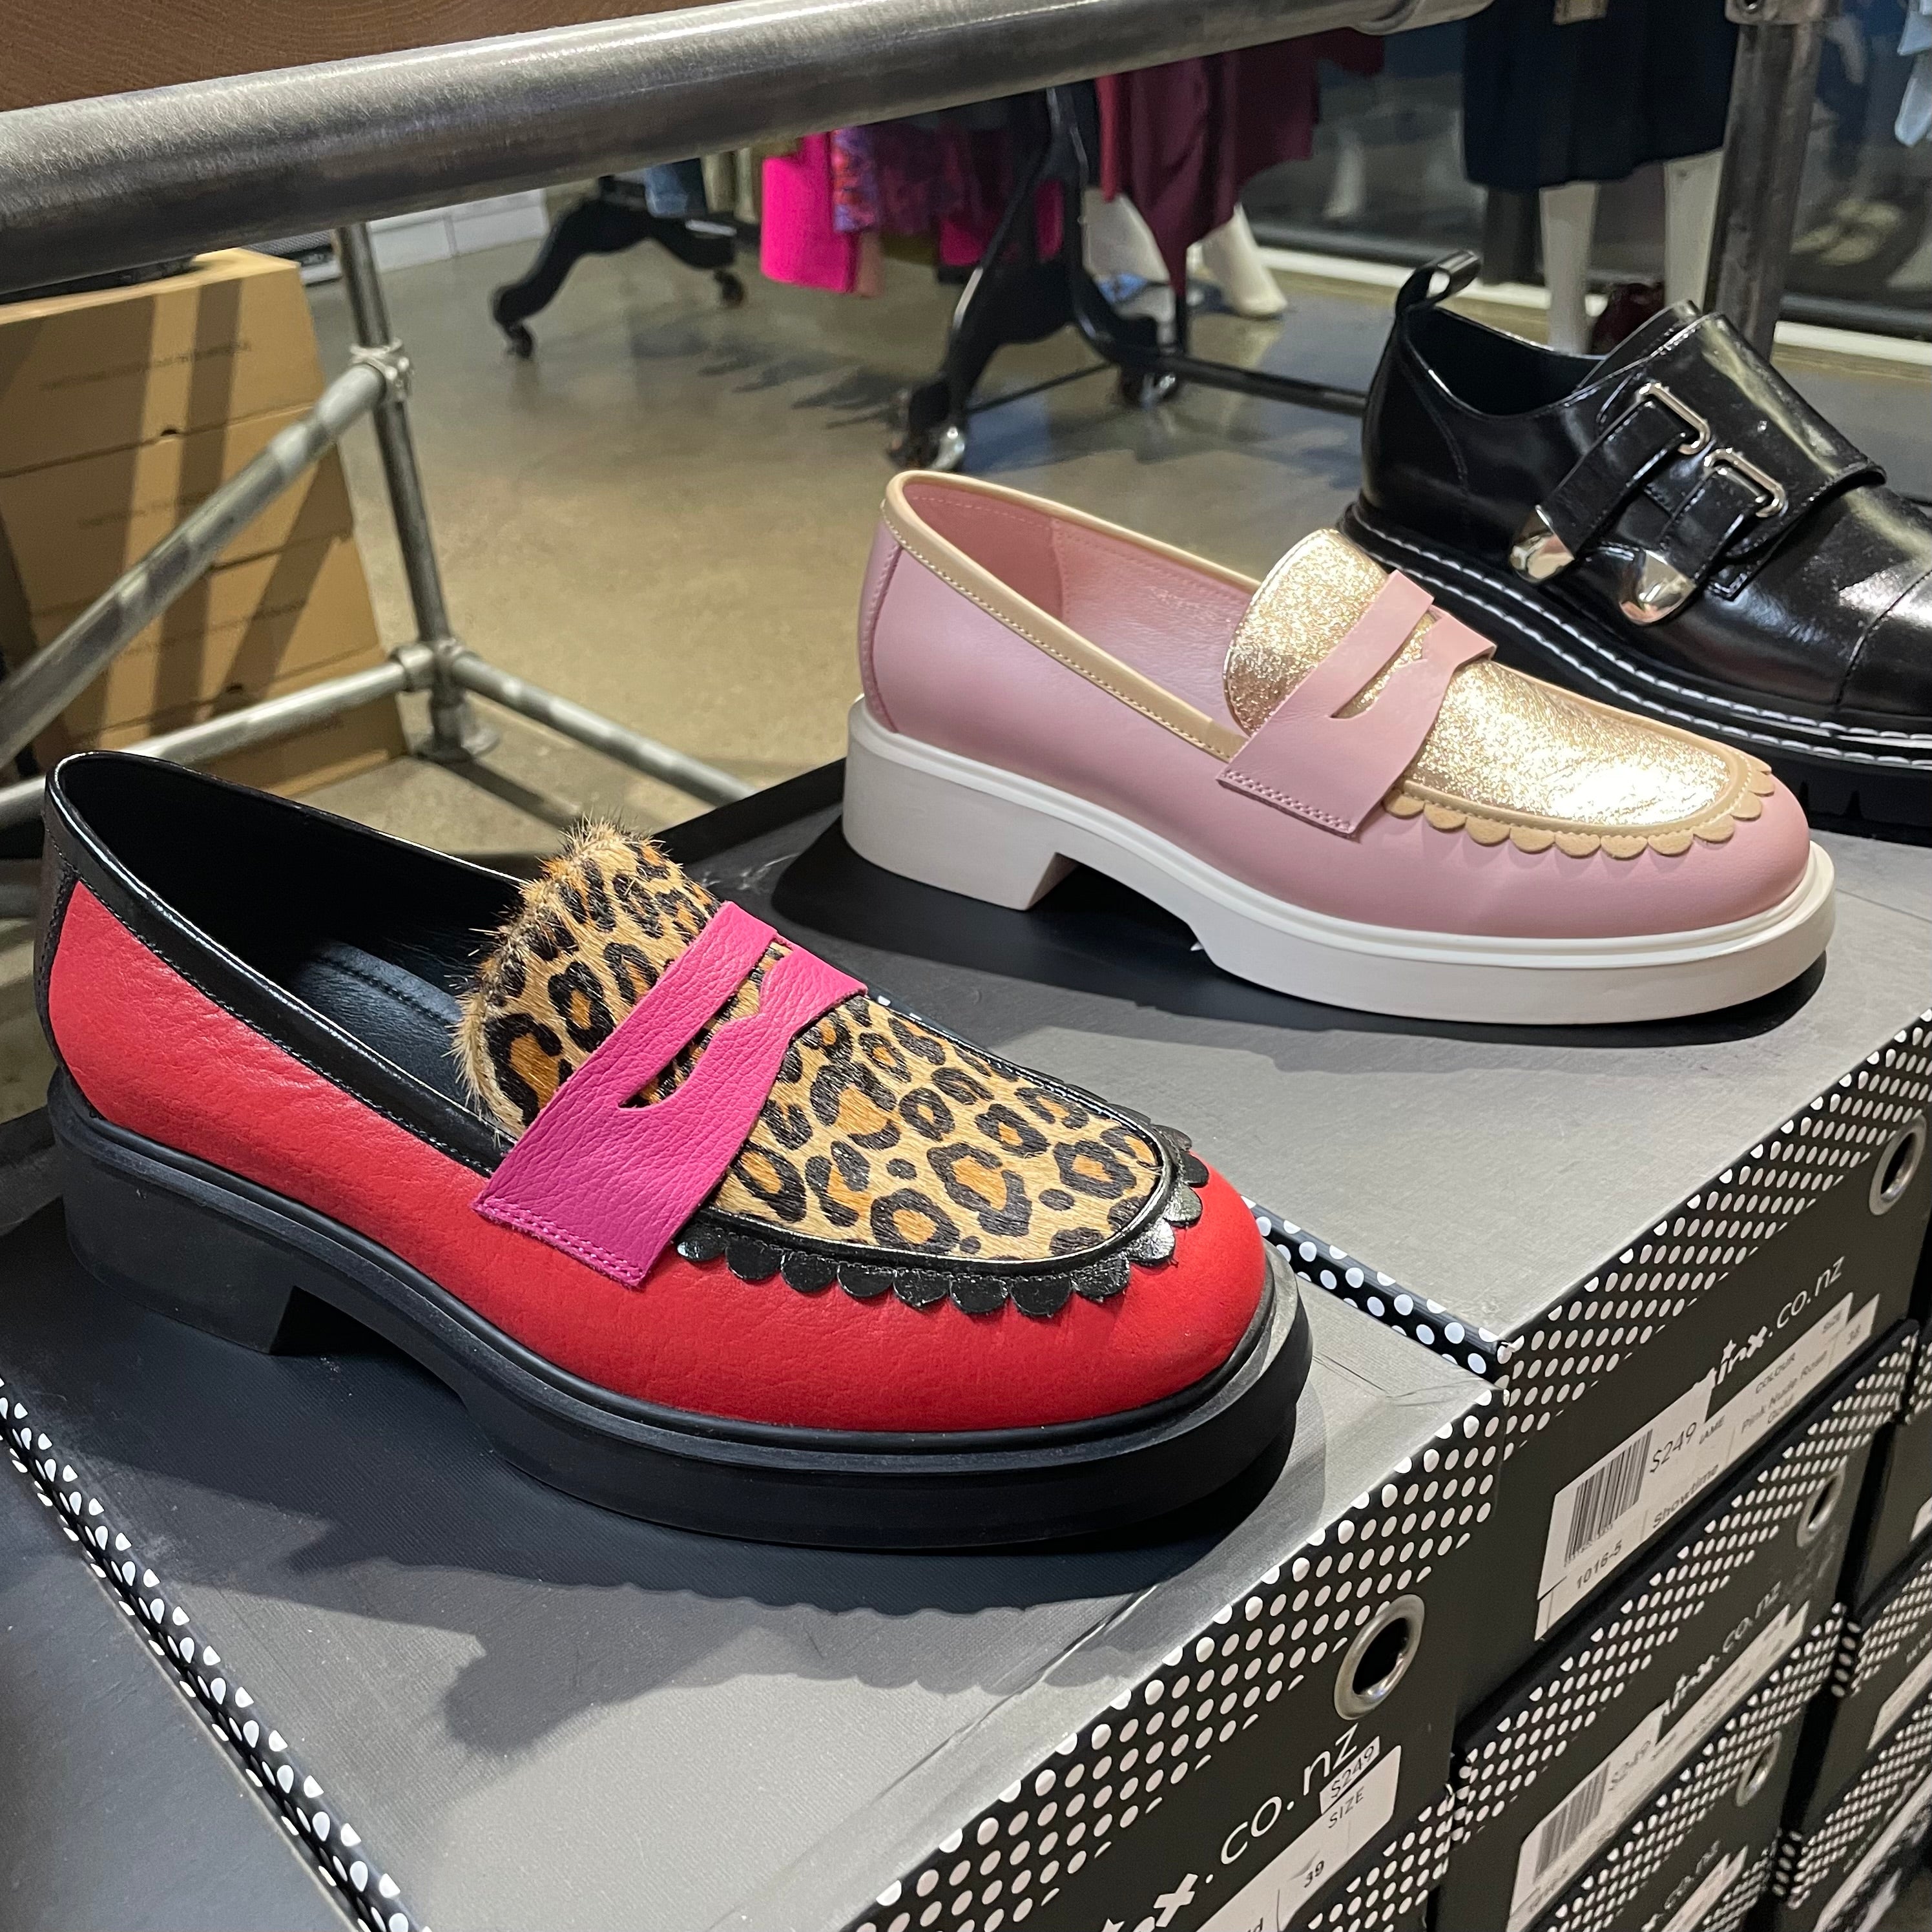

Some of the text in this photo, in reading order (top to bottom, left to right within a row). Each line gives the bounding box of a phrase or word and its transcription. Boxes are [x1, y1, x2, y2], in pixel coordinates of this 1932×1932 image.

[1576, 1539, 1623, 1590] 1016-5
[1328, 1785, 1364, 1829] SIZE
[1304, 1860, 1325, 1887] 39
